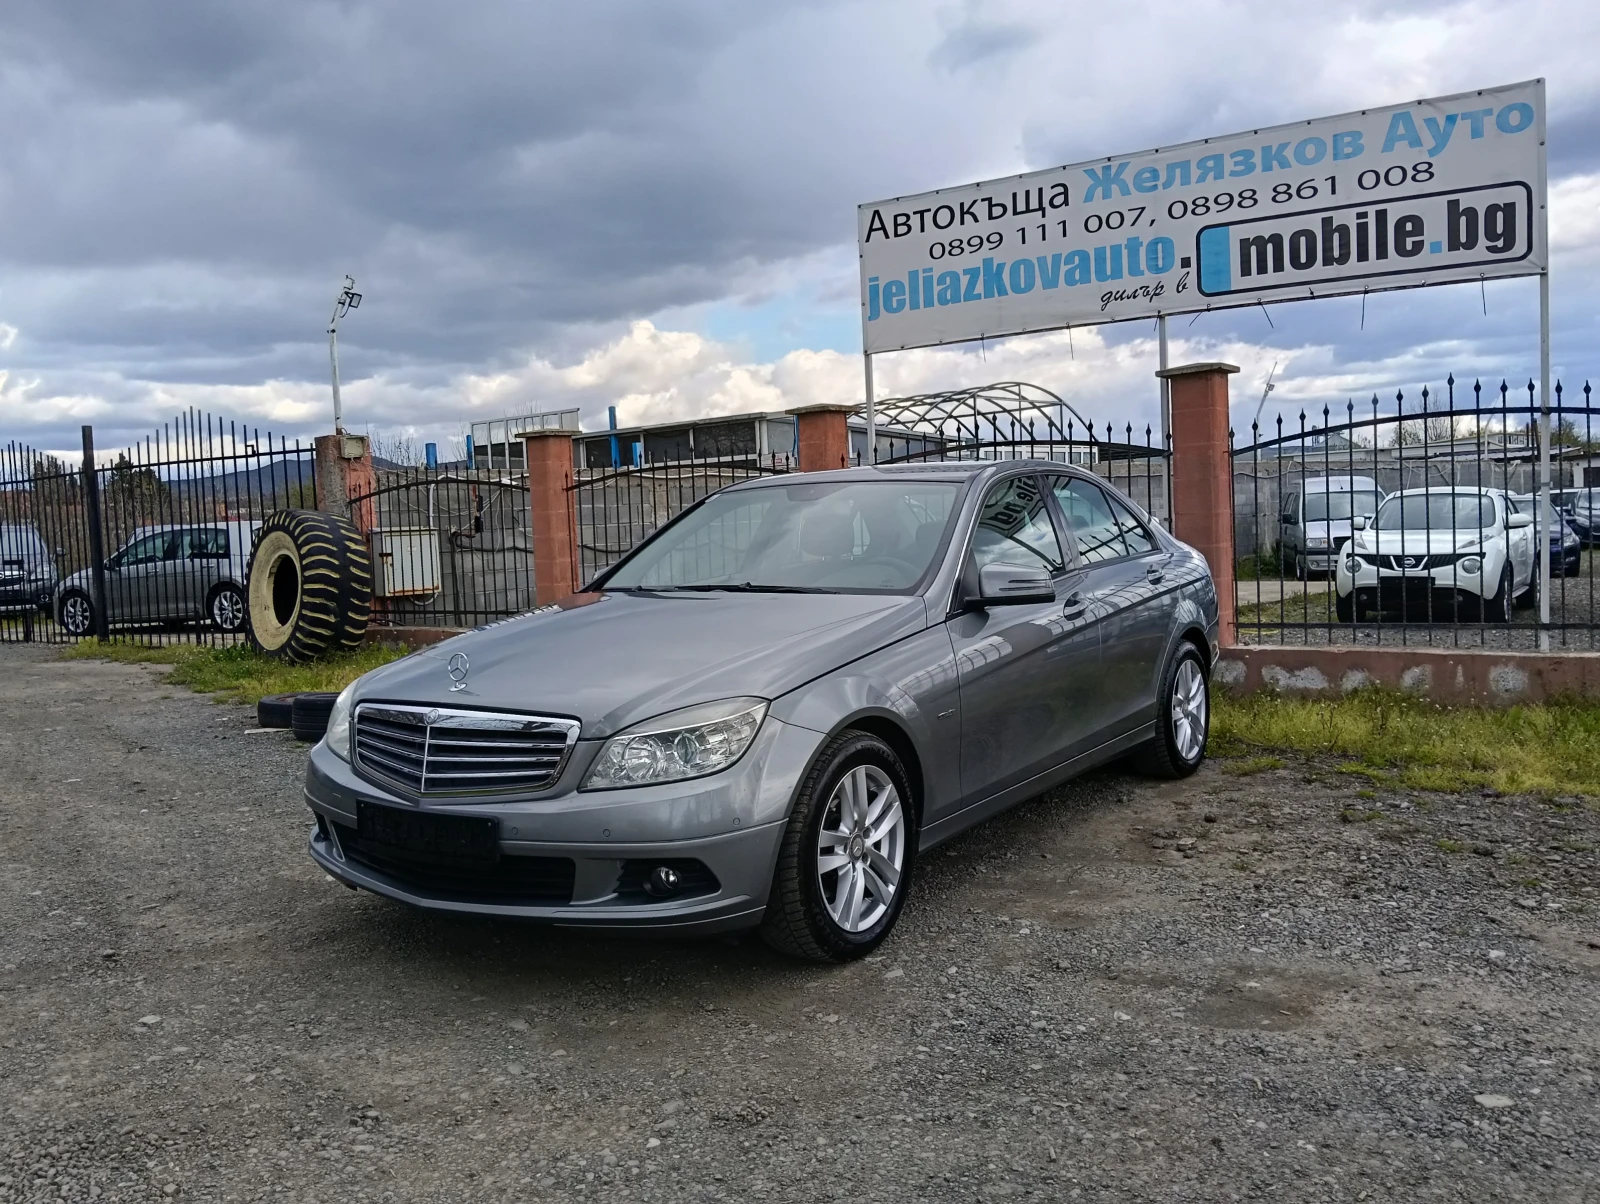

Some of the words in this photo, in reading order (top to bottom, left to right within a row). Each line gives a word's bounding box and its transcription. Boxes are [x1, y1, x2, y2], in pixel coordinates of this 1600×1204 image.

[865, 182, 1069, 243] Автокъща
[1083, 130, 1364, 203] Желязков
[1381, 102, 1534, 158] Ауто
[929, 232, 1004, 260] 0899
[1017, 220, 1068, 245] 111
[1083, 207, 1156, 234] 007,
[1167, 189, 1259, 220] 0898
[1271, 176, 1336, 204] 861
[1357, 162, 1435, 190] 008
[1239, 199, 1516, 277] mobile.bg
[1100, 281, 1165, 311] дилър
[1176, 271, 1190, 294] в
